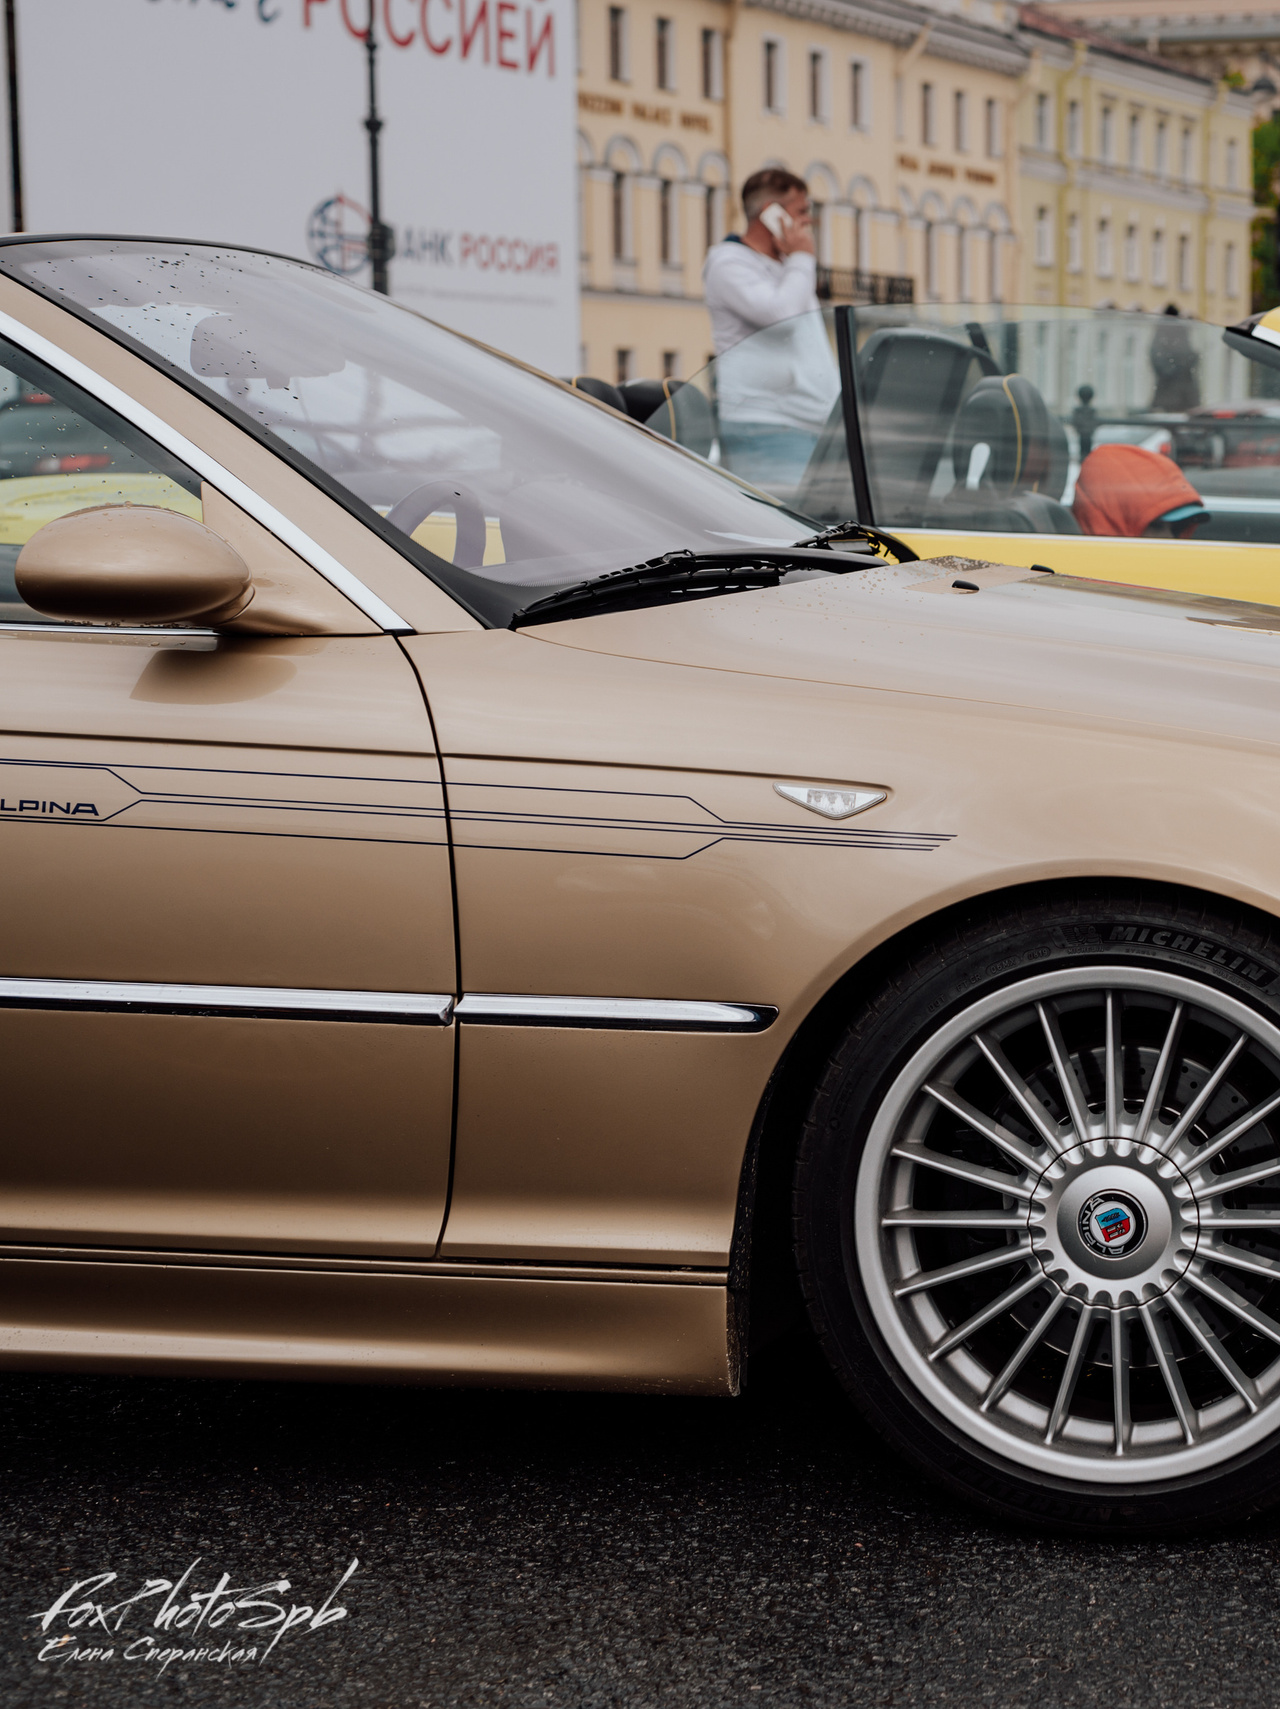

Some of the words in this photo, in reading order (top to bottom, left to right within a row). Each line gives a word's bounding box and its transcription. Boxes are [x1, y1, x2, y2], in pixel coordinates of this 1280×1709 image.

[459, 232, 560, 274] РОССИЯ
[0, 799, 99, 816] LPINA
[1108, 926, 1268, 982] MICHELIN
[1082, 1197, 1125, 1255] ALPINA
